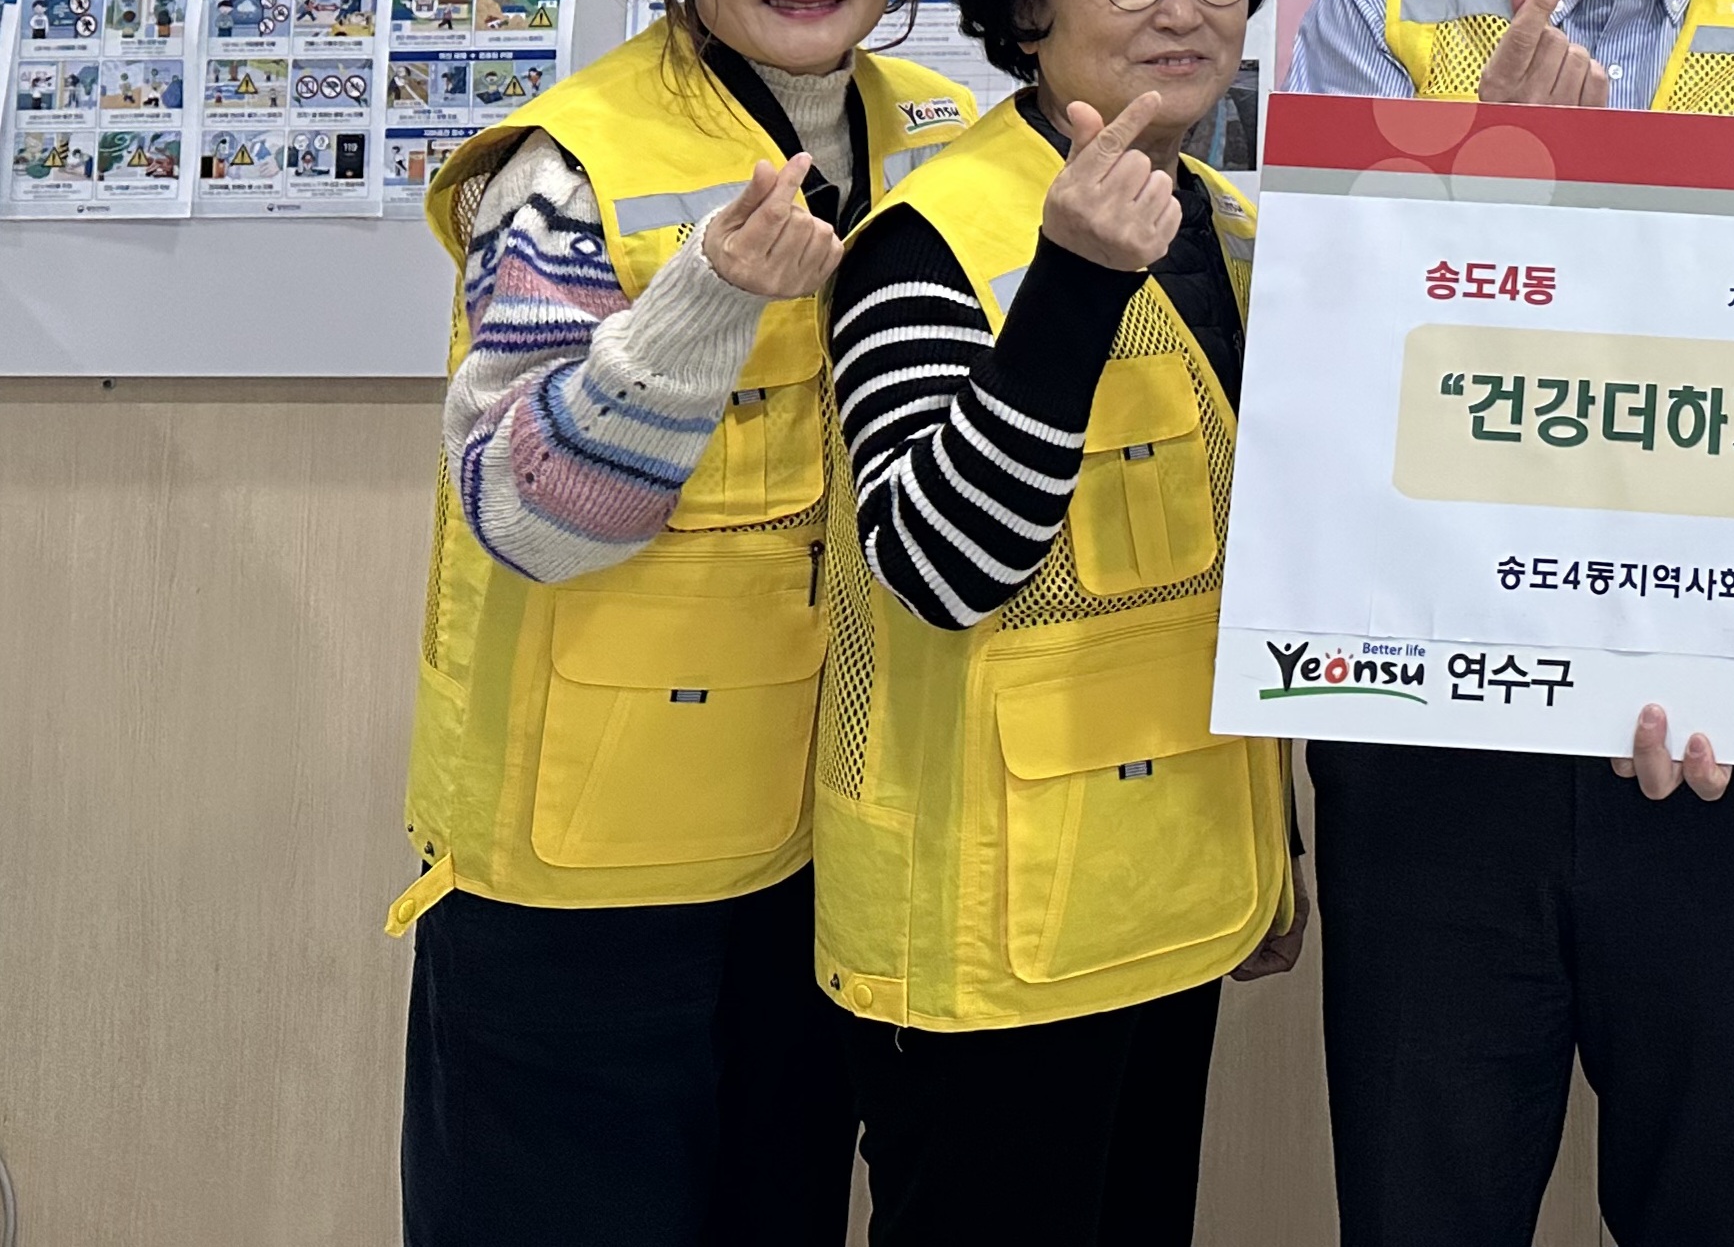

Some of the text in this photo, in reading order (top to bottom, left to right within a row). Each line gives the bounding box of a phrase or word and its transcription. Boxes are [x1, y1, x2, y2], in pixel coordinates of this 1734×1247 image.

[898, 103, 960, 127] Yeonsu
[1425, 259, 1557, 305] 송도4동
[1362, 642, 1426, 657] Better life
[1266, 641, 1574, 707] Yeonsu 연수구
